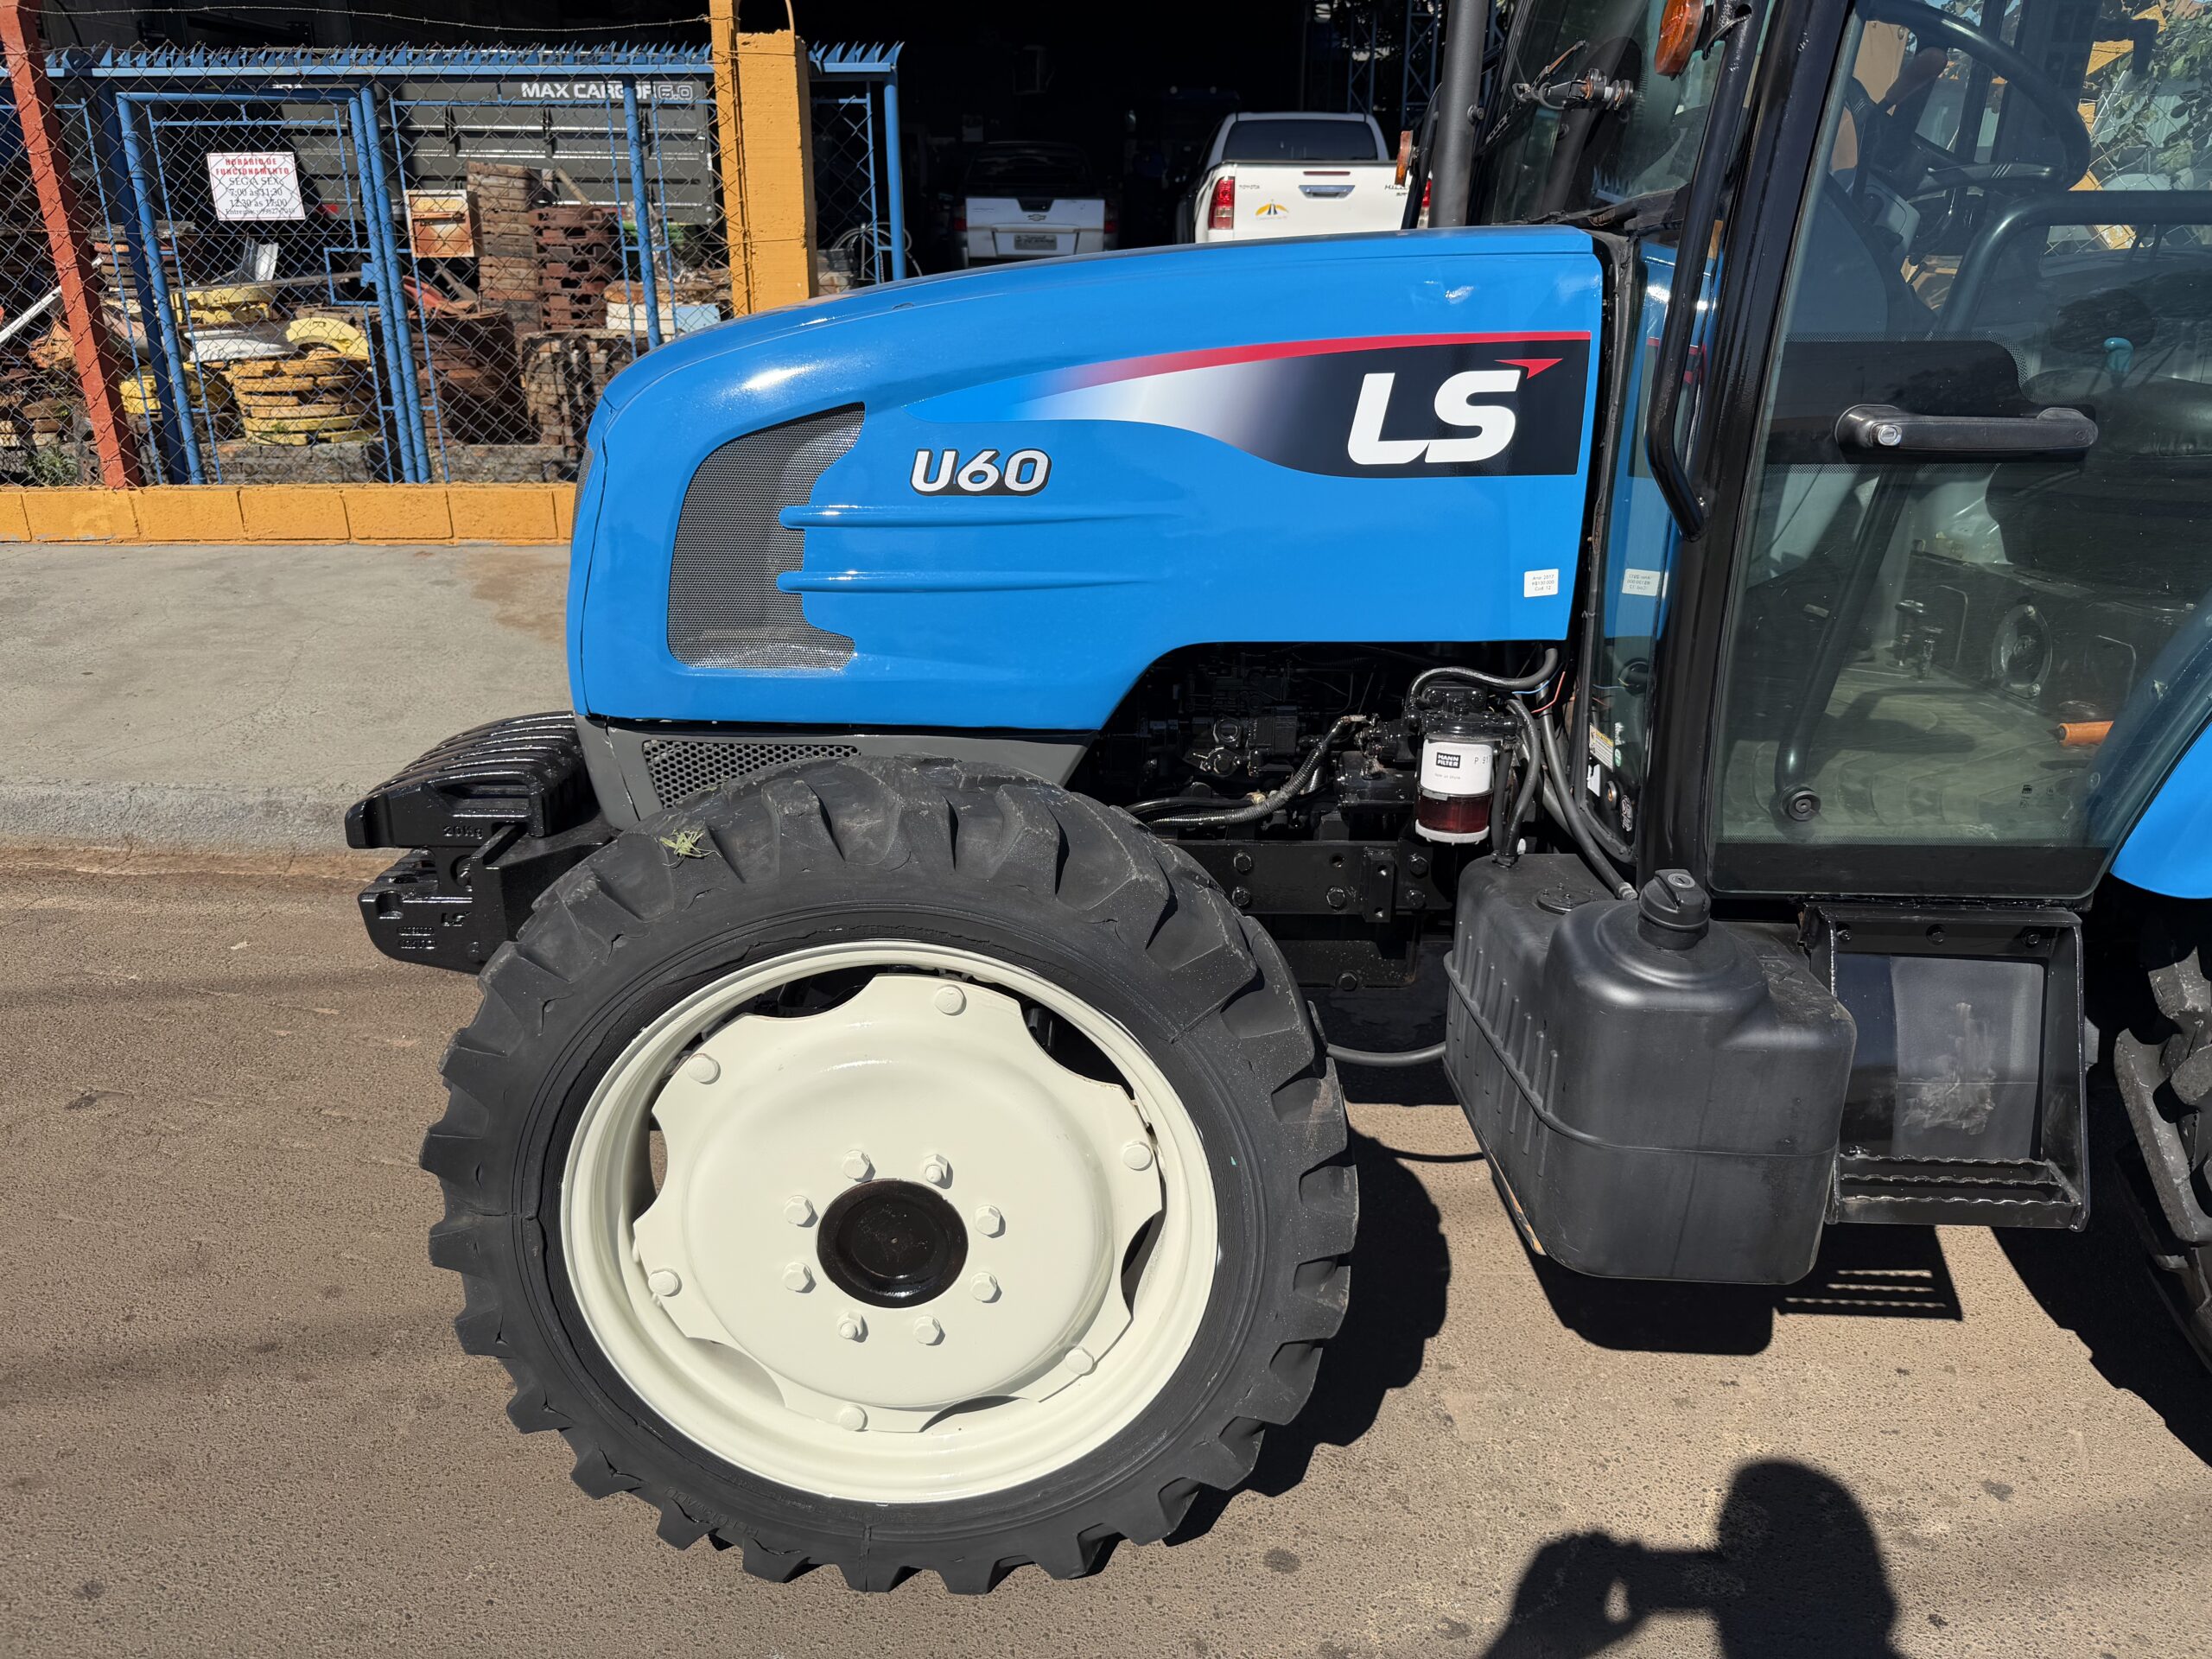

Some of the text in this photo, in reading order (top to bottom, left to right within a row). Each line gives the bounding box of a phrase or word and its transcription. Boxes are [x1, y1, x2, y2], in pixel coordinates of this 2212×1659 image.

[521, 83, 570, 99] MAX
[1347, 369, 1522, 466] LS
[910, 448, 1052, 496] U60
[1438, 753, 1459, 762] MANN
[442, 824, 484, 840] 20Kg
